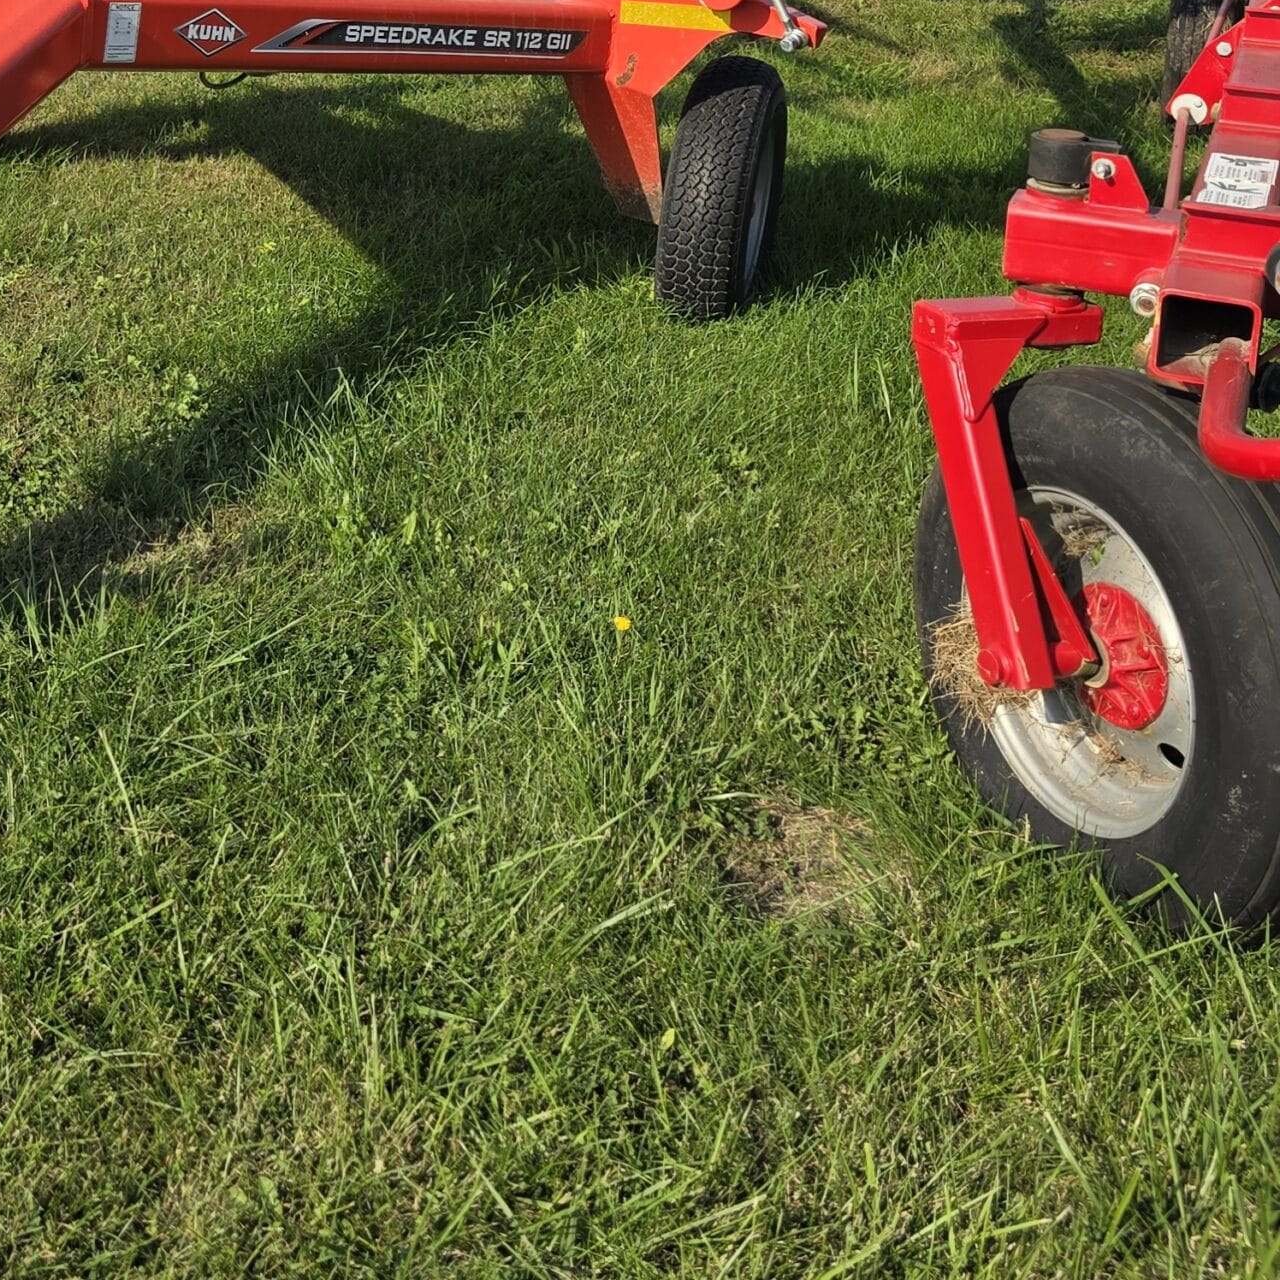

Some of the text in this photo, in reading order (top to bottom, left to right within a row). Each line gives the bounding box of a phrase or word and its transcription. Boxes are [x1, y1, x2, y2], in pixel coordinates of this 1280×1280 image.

[187, 23, 235, 42] KUHN
[345, 24, 571, 51] SPEEDRAKE SR 112 GII
